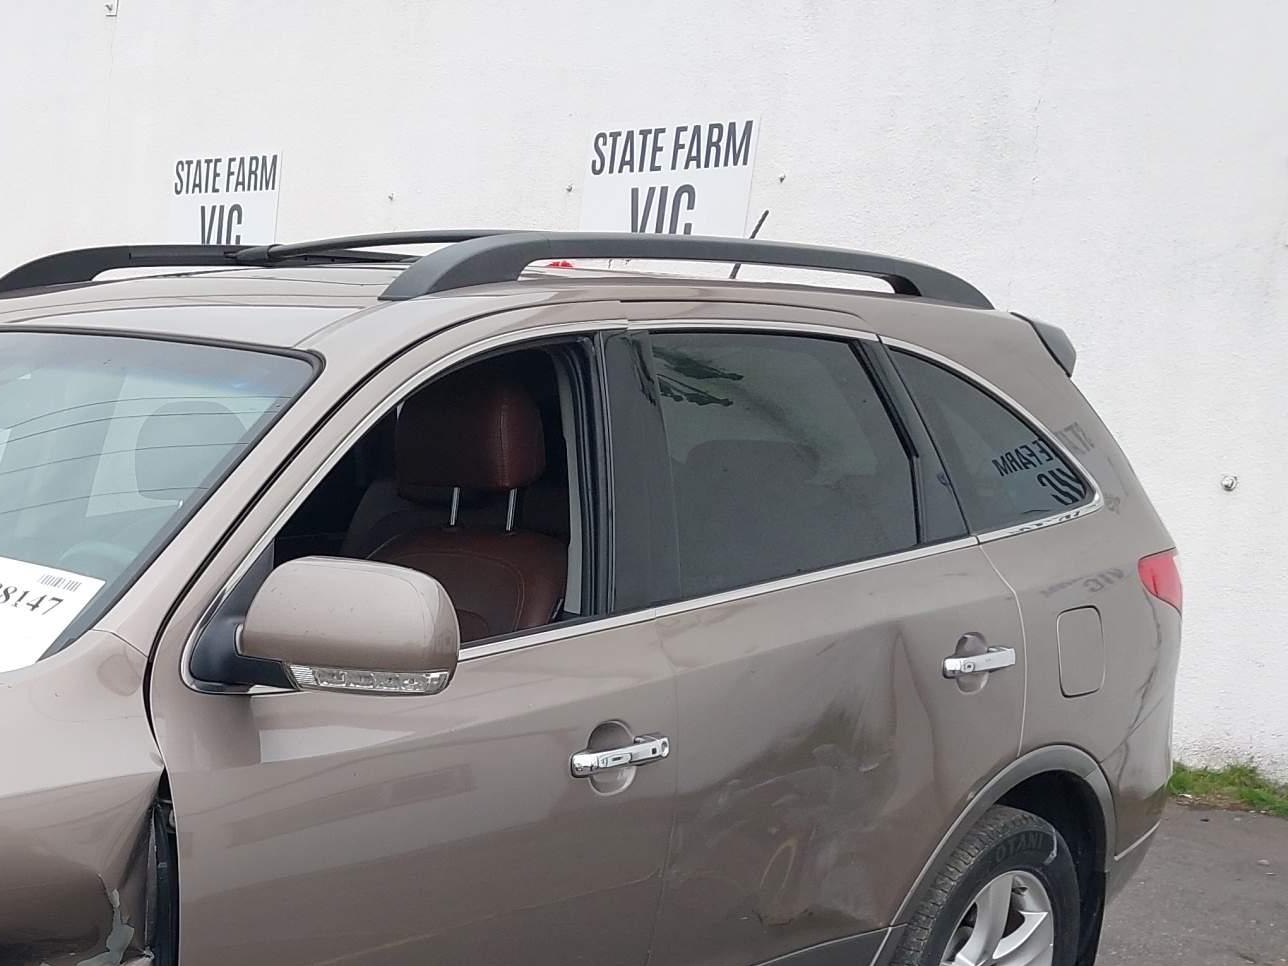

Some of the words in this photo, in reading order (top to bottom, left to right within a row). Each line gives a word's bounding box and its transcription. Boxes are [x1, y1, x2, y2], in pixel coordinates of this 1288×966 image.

[591, 128, 666, 176] STATE
[670, 120, 754, 170] FARM
[174, 158, 223, 196] STATE
[225, 154, 277, 193] FARM
[200, 204, 243, 245] VIC
[630, 184, 695, 235] VIC
